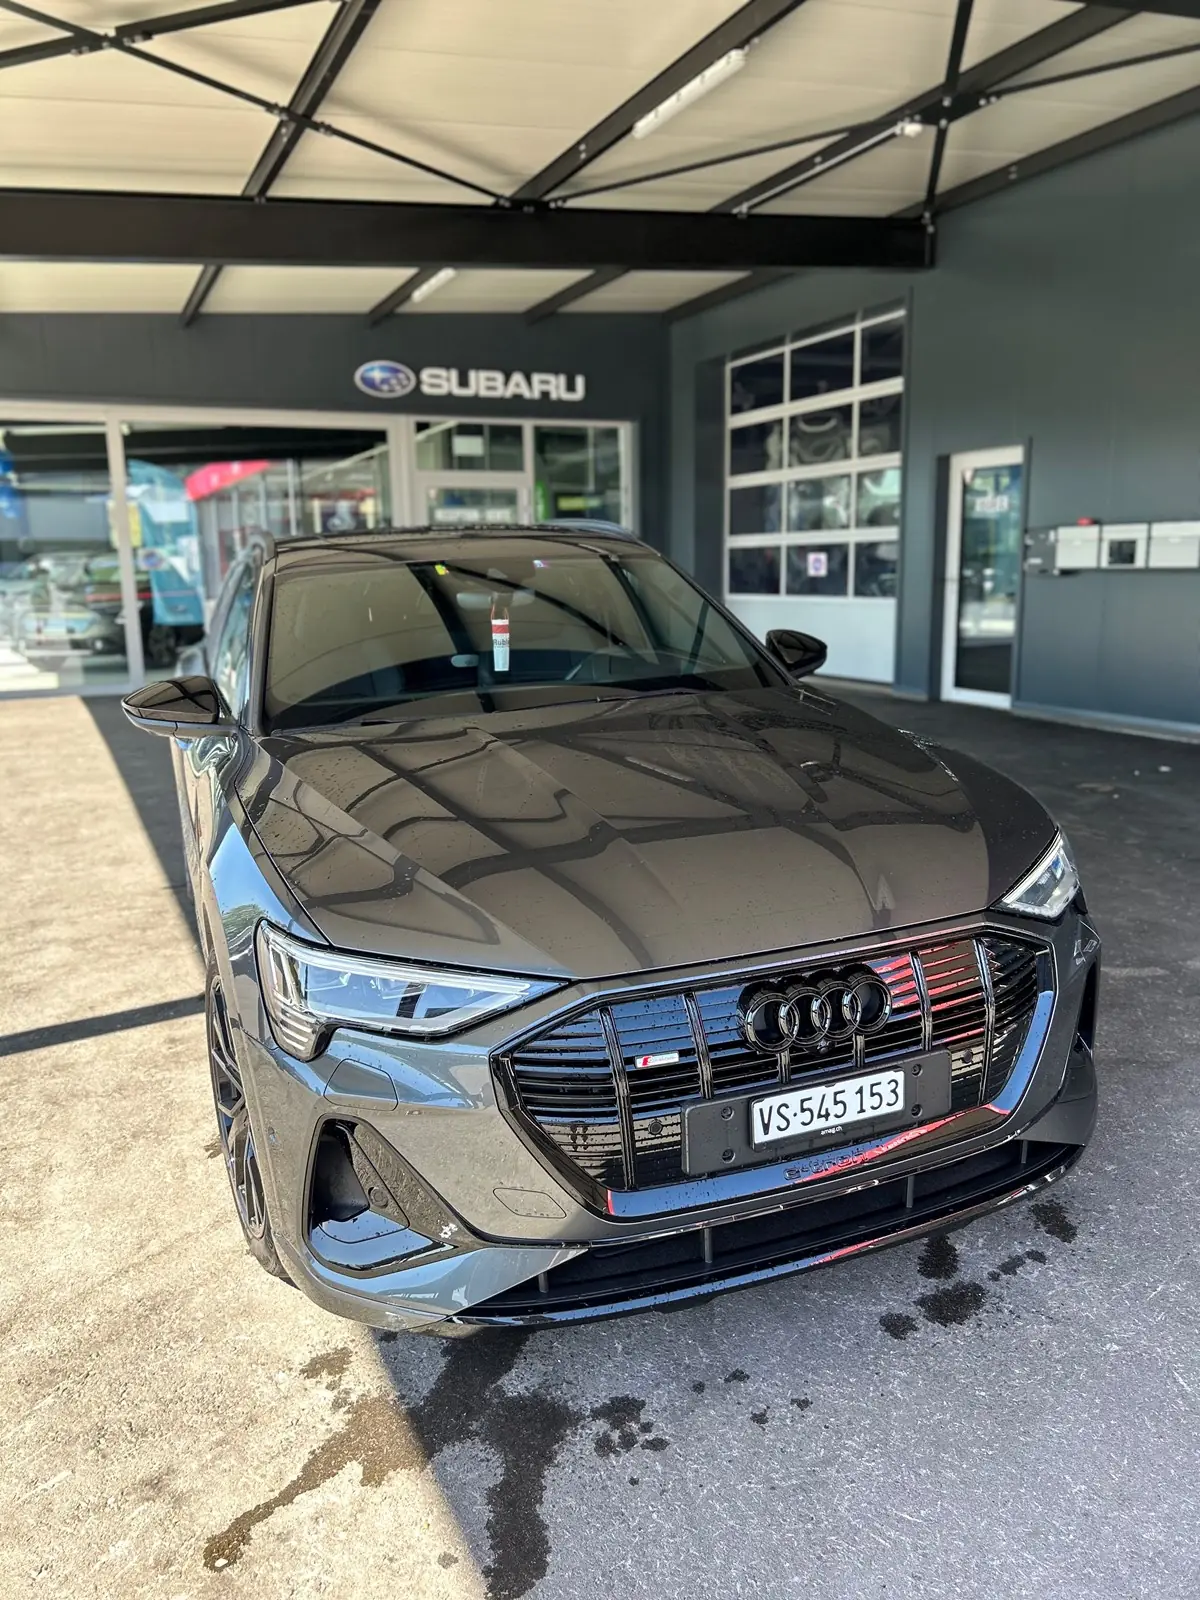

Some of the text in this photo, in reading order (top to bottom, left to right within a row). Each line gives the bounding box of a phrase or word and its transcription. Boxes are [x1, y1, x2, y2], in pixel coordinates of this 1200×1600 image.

[419, 366, 585, 401] SUBARU
[854, 1078, 899, 1115] 153
[820, 1125, 843, 1136] amag.ch
